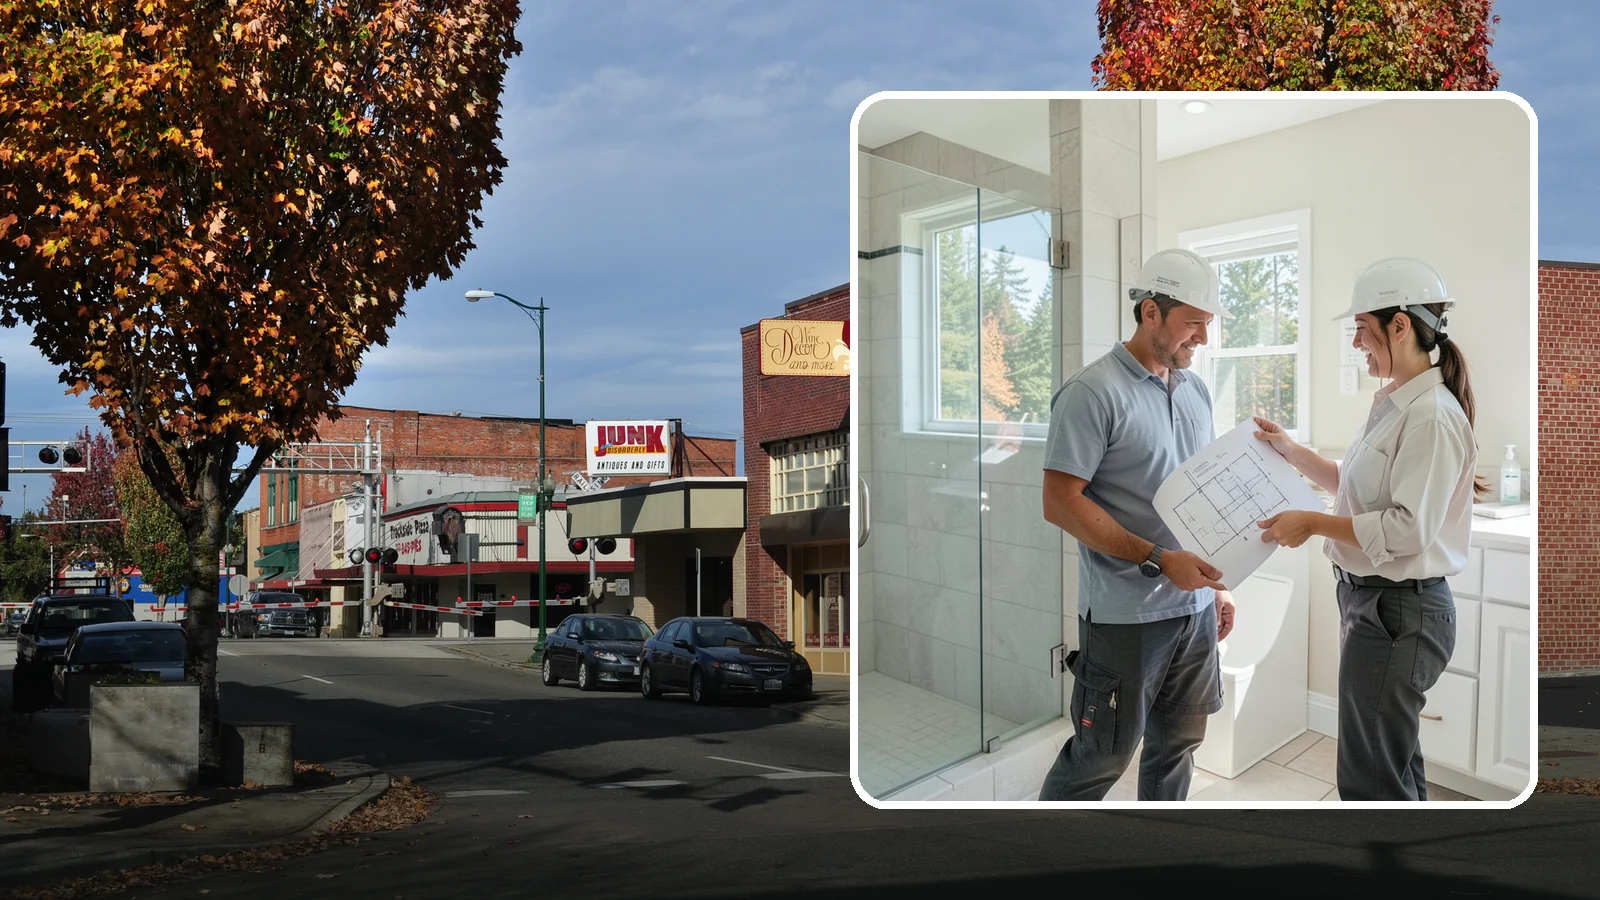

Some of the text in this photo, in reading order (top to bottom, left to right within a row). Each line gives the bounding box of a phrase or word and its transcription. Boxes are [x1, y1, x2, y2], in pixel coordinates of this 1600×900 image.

[765, 328, 831, 365] Decor
[595, 425, 665, 457] JUNK
[597, 461, 665, 470] ANTIQUES AND GIFTS
[573, 474, 589, 492] RAIL
[390, 519, 429, 539] Trackside Pizza
